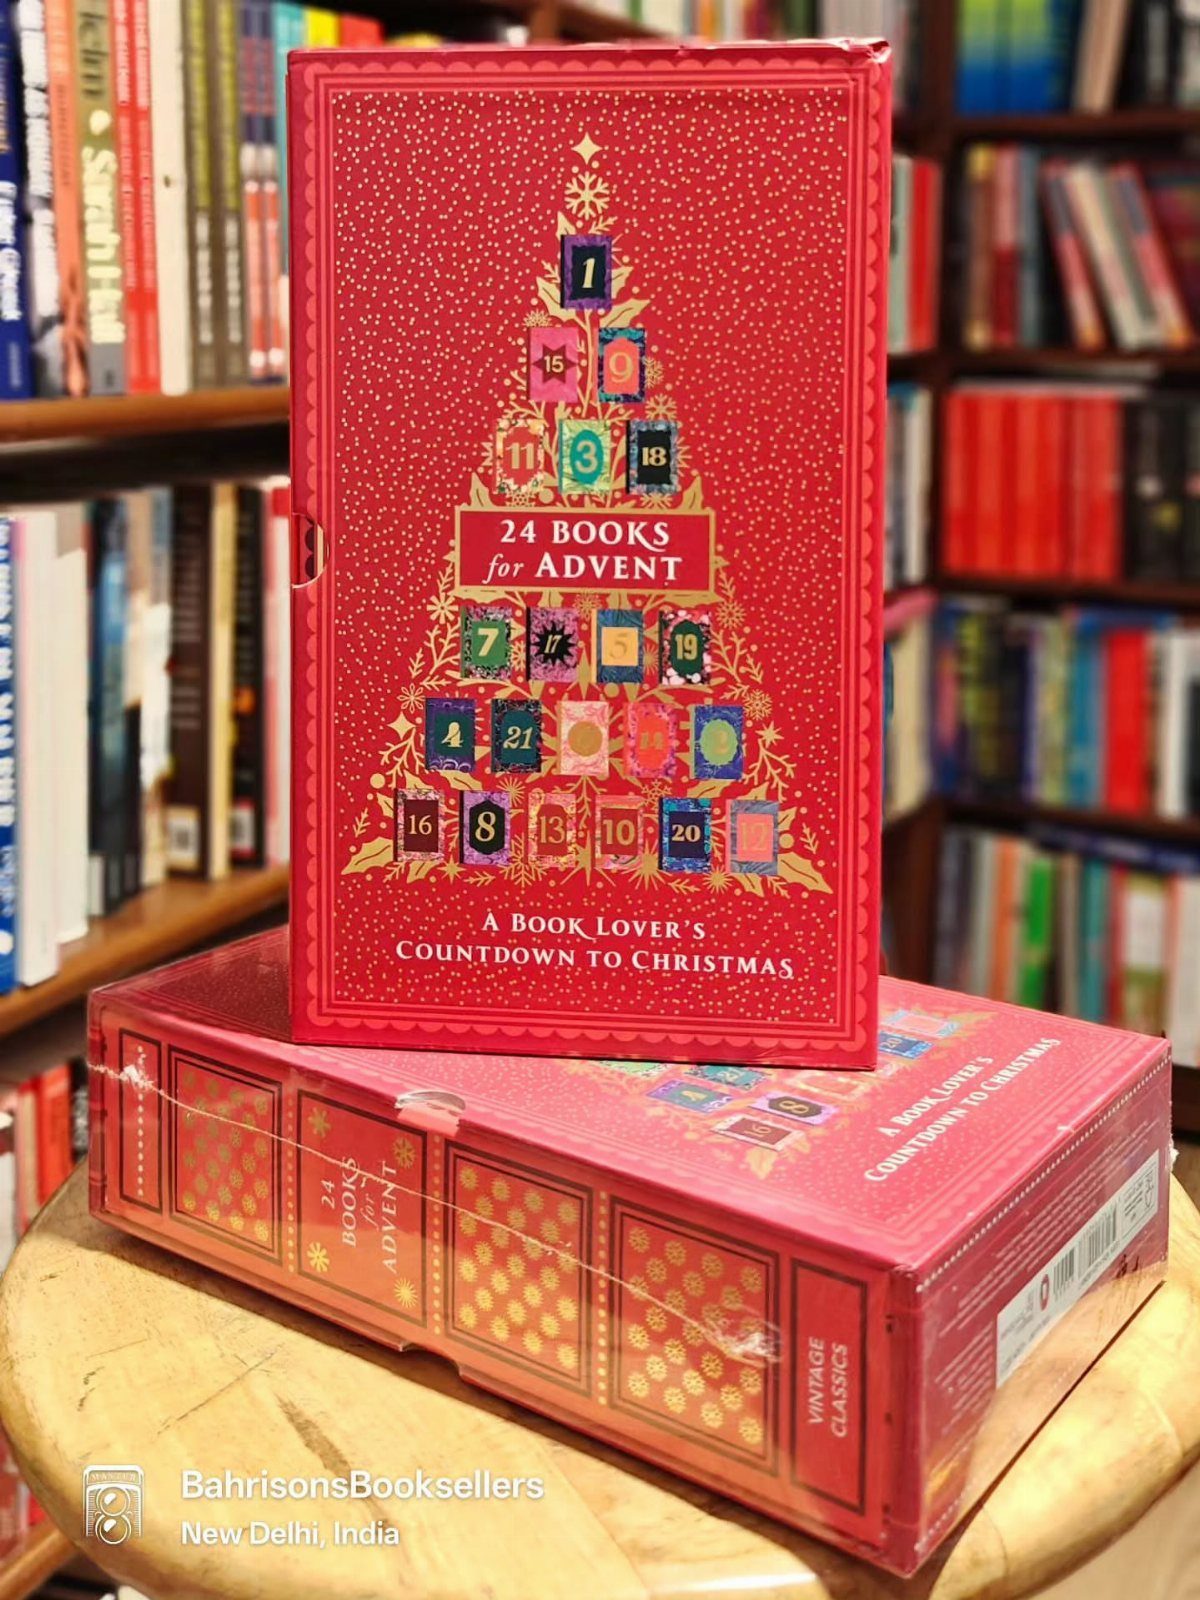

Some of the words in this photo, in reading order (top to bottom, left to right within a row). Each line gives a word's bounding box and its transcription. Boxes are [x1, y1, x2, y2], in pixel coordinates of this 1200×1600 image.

[582, 258, 596, 289] 1
[543, 355, 564, 374] 15
[608, 352, 634, 384] 9
[506, 442, 534, 470] 11
[575, 440, 598, 474] 3
[641, 446, 668, 467] 18
[500, 520, 537, 544] 24
[552, 520, 670, 552] BOOKS
[482, 554, 524, 584] for
[535, 552, 683, 582] ADVENT
[477, 628, 500, 658] 7
[544, 634, 561, 654] 17
[609, 632, 629, 660] 5
[674, 634, 698, 661] 19
[441, 721, 465, 748] 4
[503, 726, 534, 750] 21
[409, 814, 433, 836] 16
[475, 811, 497, 843] 8
[539, 816, 566, 845] 13
[602, 819, 637, 847] 10
[671, 824, 702, 843] 20
[481, 911, 500, 932] A
[510, 913, 599, 940] BOOK
[597, 917, 706, 940] LOVER'S
[395, 939, 577, 967] COUNTDOWN
[586, 950, 623, 970] TO
[631, 950, 795, 980] CHRISTMAS
[779, 1100, 809, 1114] 8
[863, 1107, 969, 1182] COUNTDOWN
[960, 1091, 989, 1107] TO
[980, 1038, 1061, 1091] CHRISTMAS
[877, 1126, 901, 1137] A
[889, 1096, 952, 1126] BOOK
[743, 1124, 772, 1138] 16
[320, 1179, 336, 1210] 24
[340, 1156, 360, 1248] BOOKS
[360, 1193, 379, 1232] for
[381, 1160, 398, 1274] ADVENT
[808, 1337, 825, 1425] VINTAGE
[831, 1342, 848, 1438] CLASSICS
